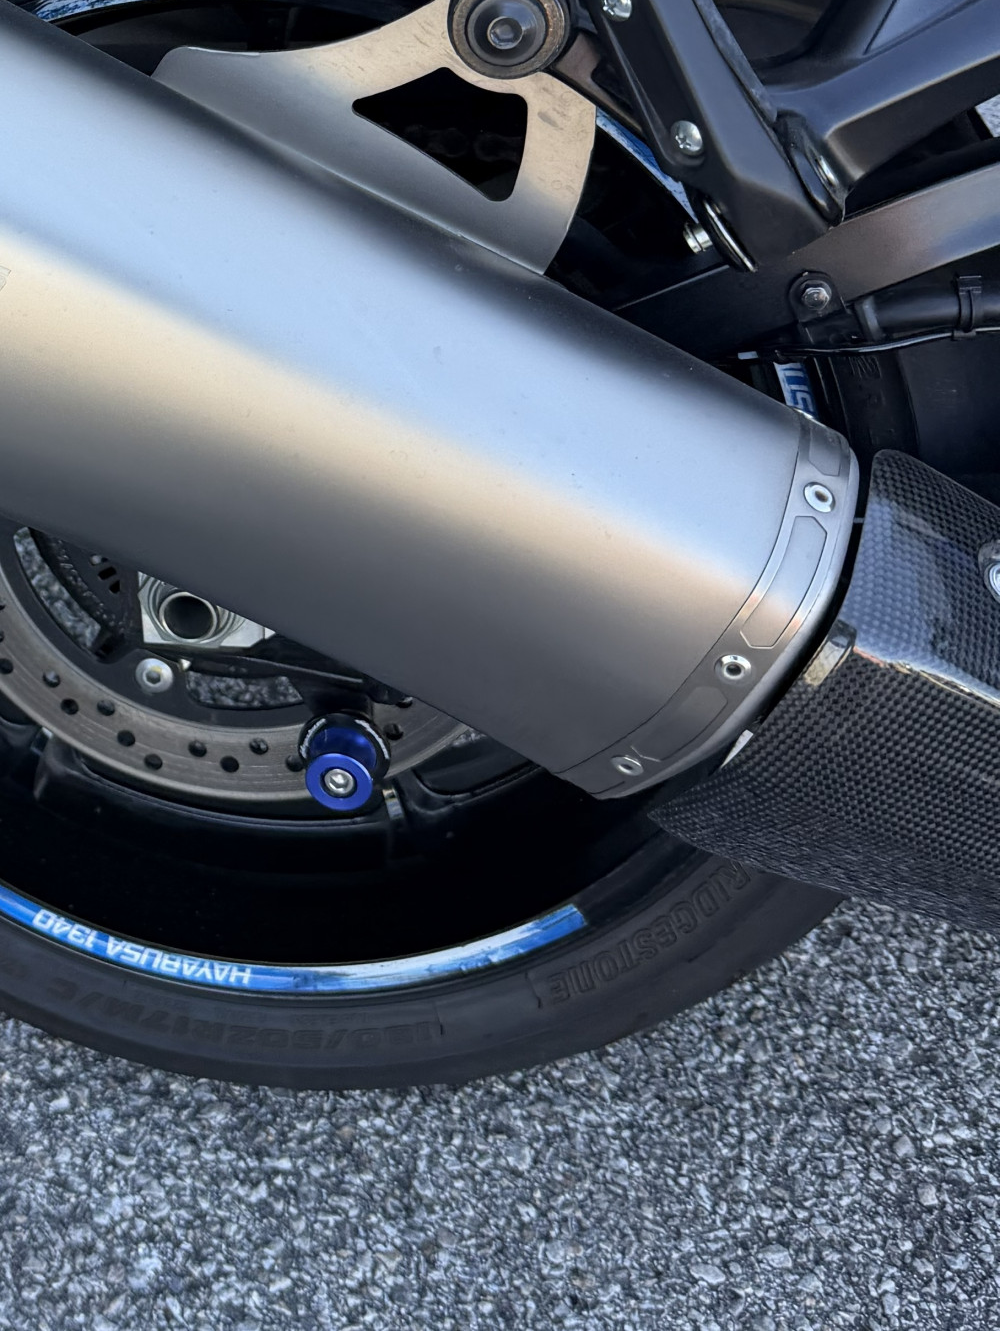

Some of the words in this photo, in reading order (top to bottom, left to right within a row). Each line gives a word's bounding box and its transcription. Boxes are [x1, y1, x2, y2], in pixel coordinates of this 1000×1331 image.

[32, 908, 98, 950] 1340
[546, 862, 752, 1006] RIDGESTONE
[106, 936, 252, 985] HAYABUSA
